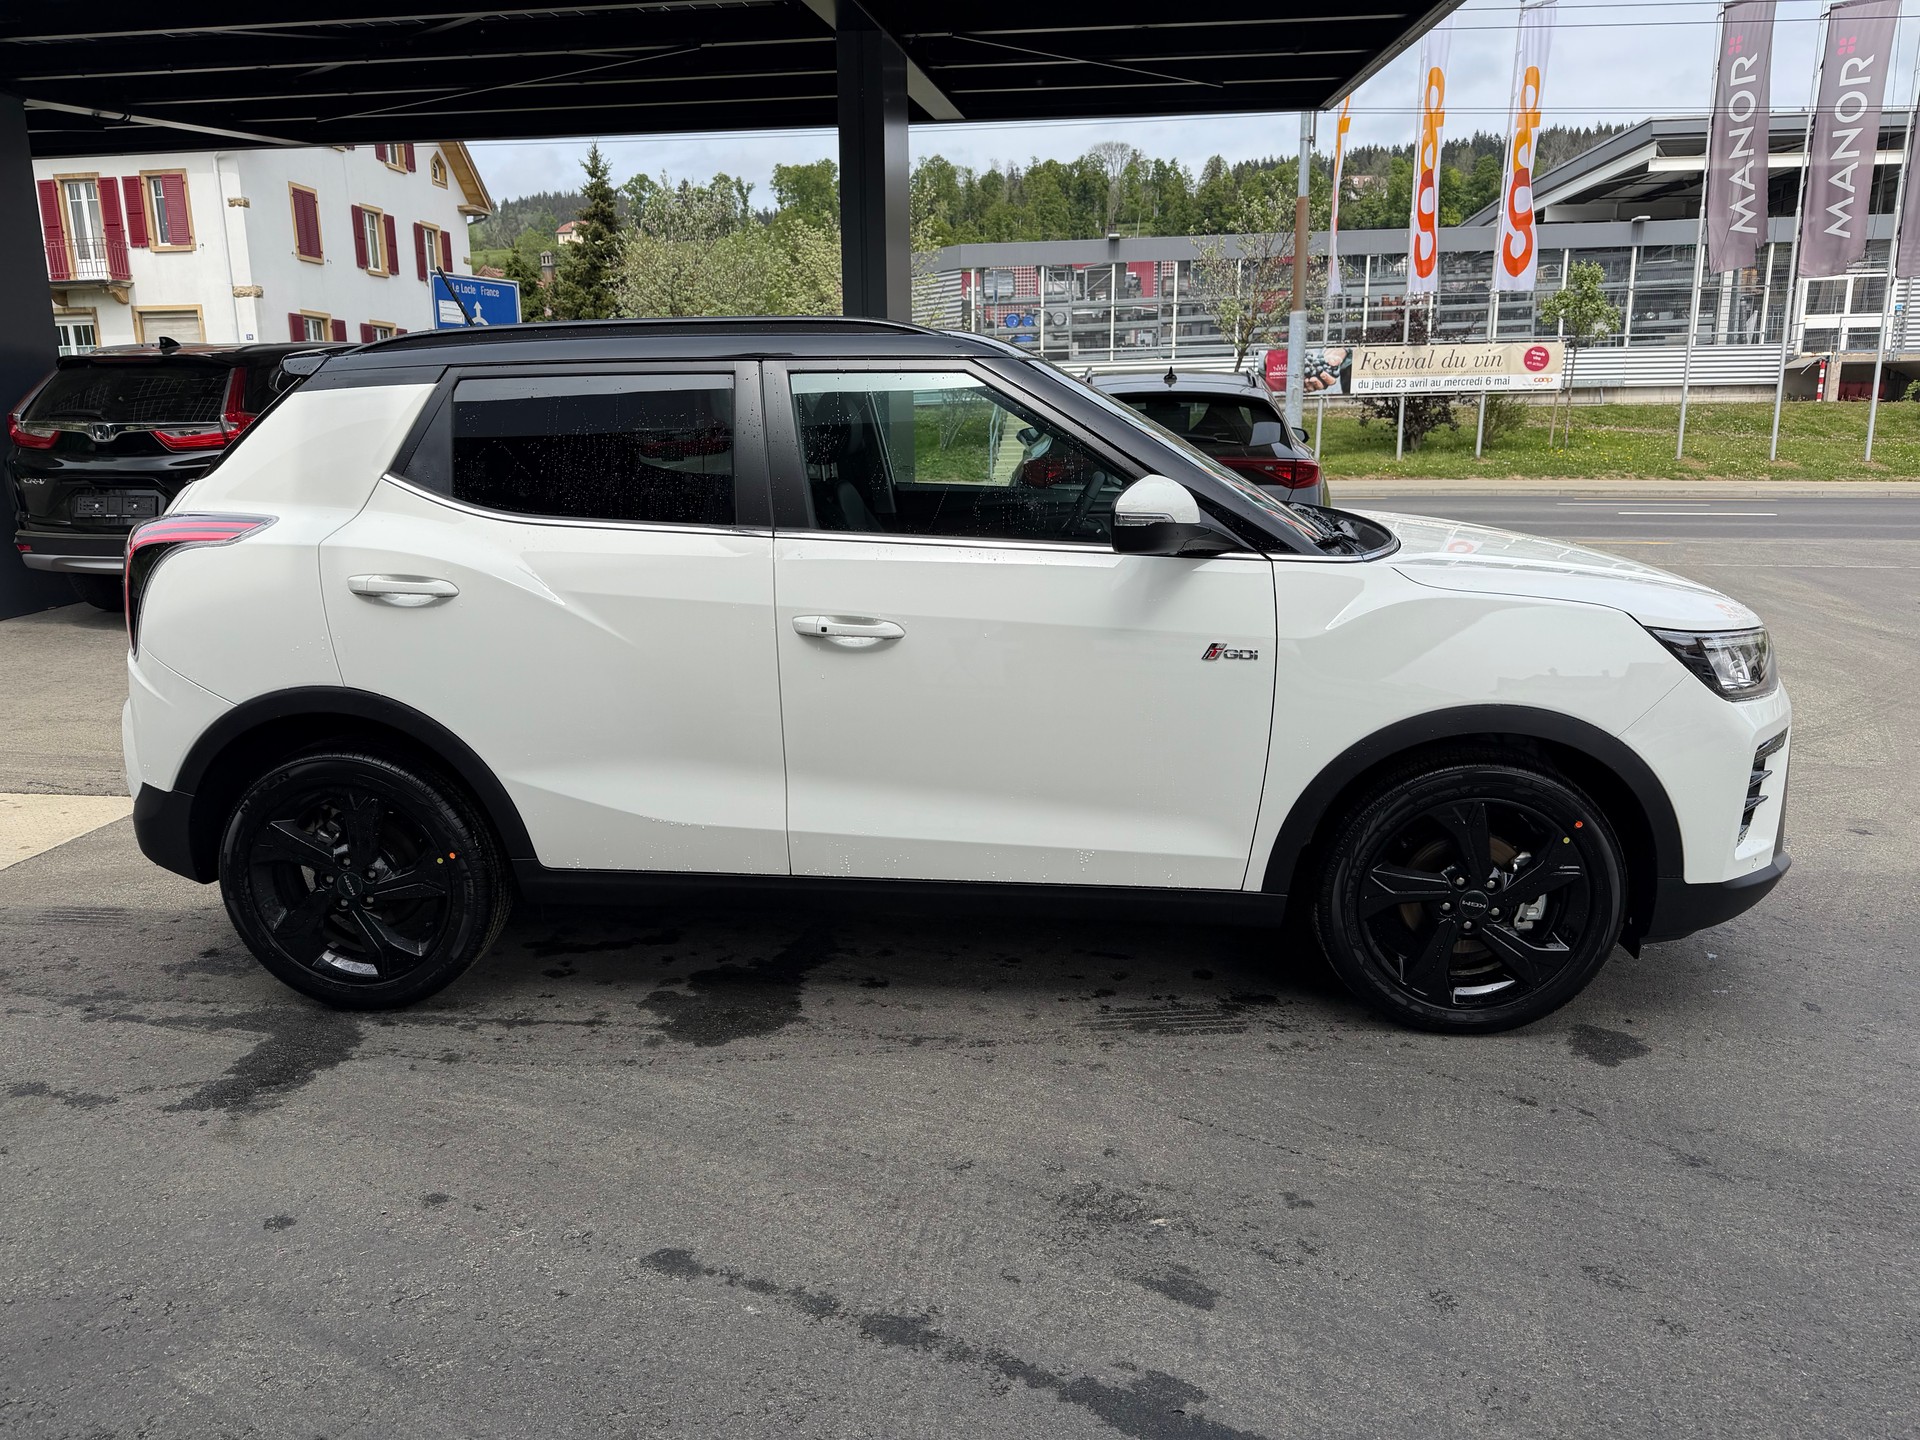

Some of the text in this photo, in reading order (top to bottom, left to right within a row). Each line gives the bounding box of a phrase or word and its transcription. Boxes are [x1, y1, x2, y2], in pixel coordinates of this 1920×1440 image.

[1414, 66, 1445, 279] coop
[1503, 66, 1542, 278] coop
[1728, 53, 1758, 234] MANOR
[1823, 54, 1875, 239] MANOR
[480, 286, 500, 298] France
[1357, 380, 1369, 389] du
[1371, 379, 1393, 390] jeudi
[1395, 379, 1407, 388] 23
[1409, 379, 1428, 388] avril
[1444, 377, 1483, 386] mercredi
[1485, 376, 1492, 385] 6
[1494, 376, 1510, 385] mai
[1359, 348, 1503, 371] Festival du vin
[1462, 900, 1486, 909] KGM
